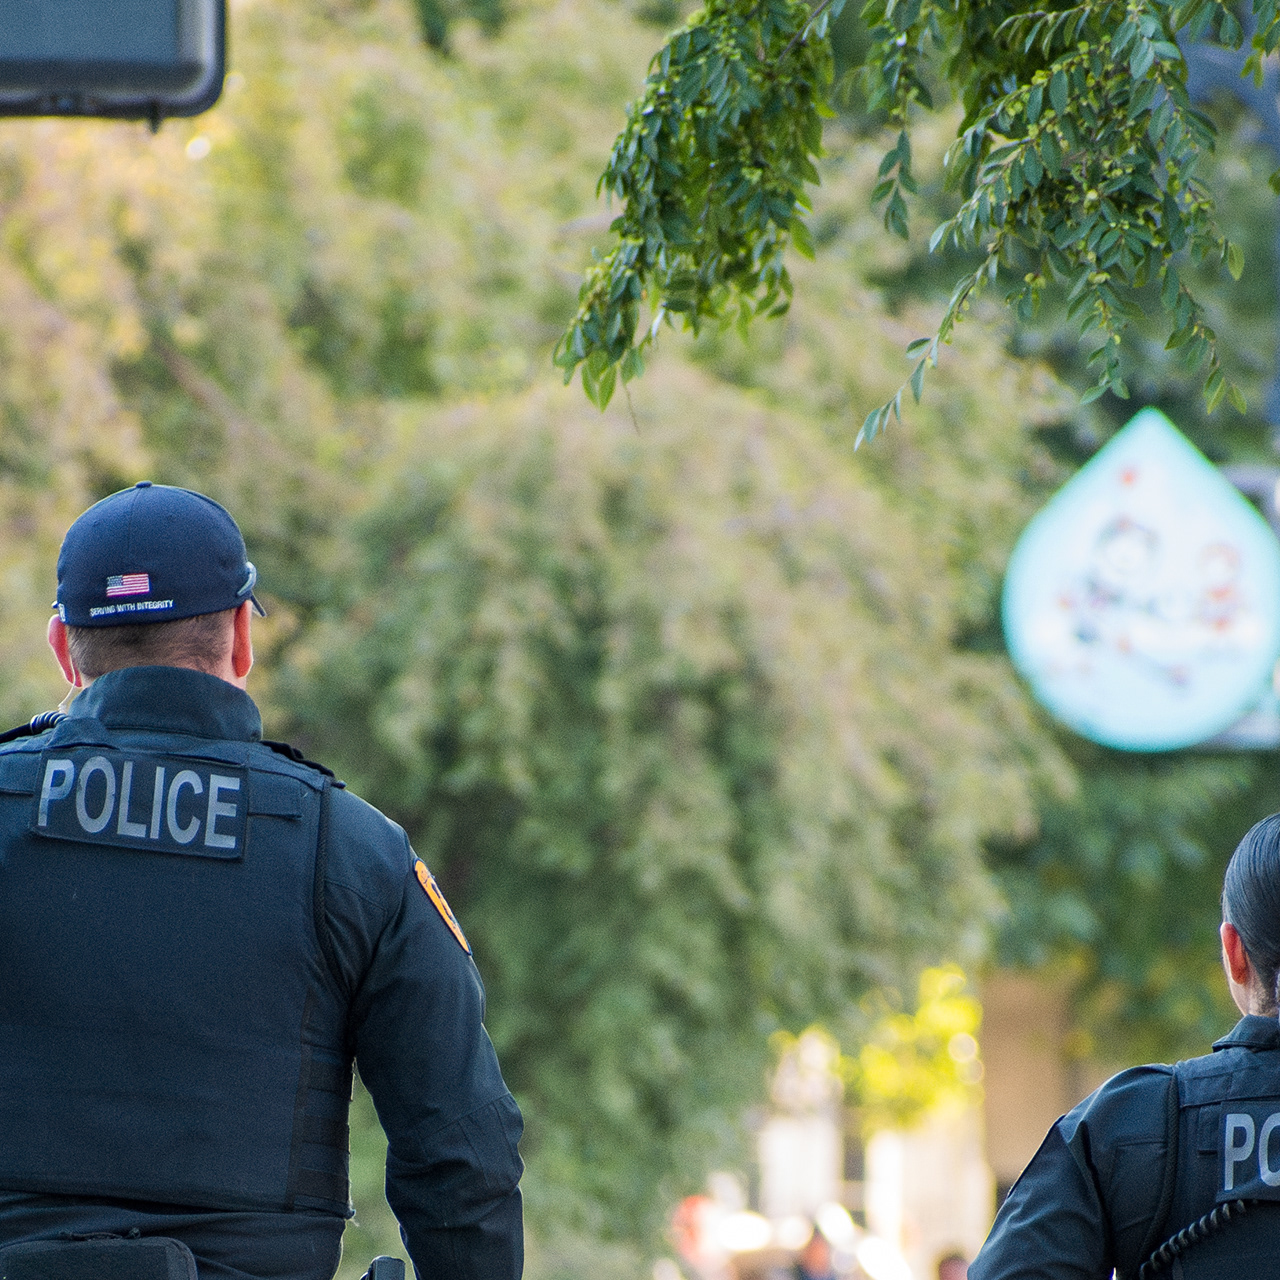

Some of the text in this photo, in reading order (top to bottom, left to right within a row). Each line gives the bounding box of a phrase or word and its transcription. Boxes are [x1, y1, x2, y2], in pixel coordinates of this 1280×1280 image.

[90, 599, 174, 617] SERVING WITH INTEGRITY
[37, 755, 241, 849] POLICE
